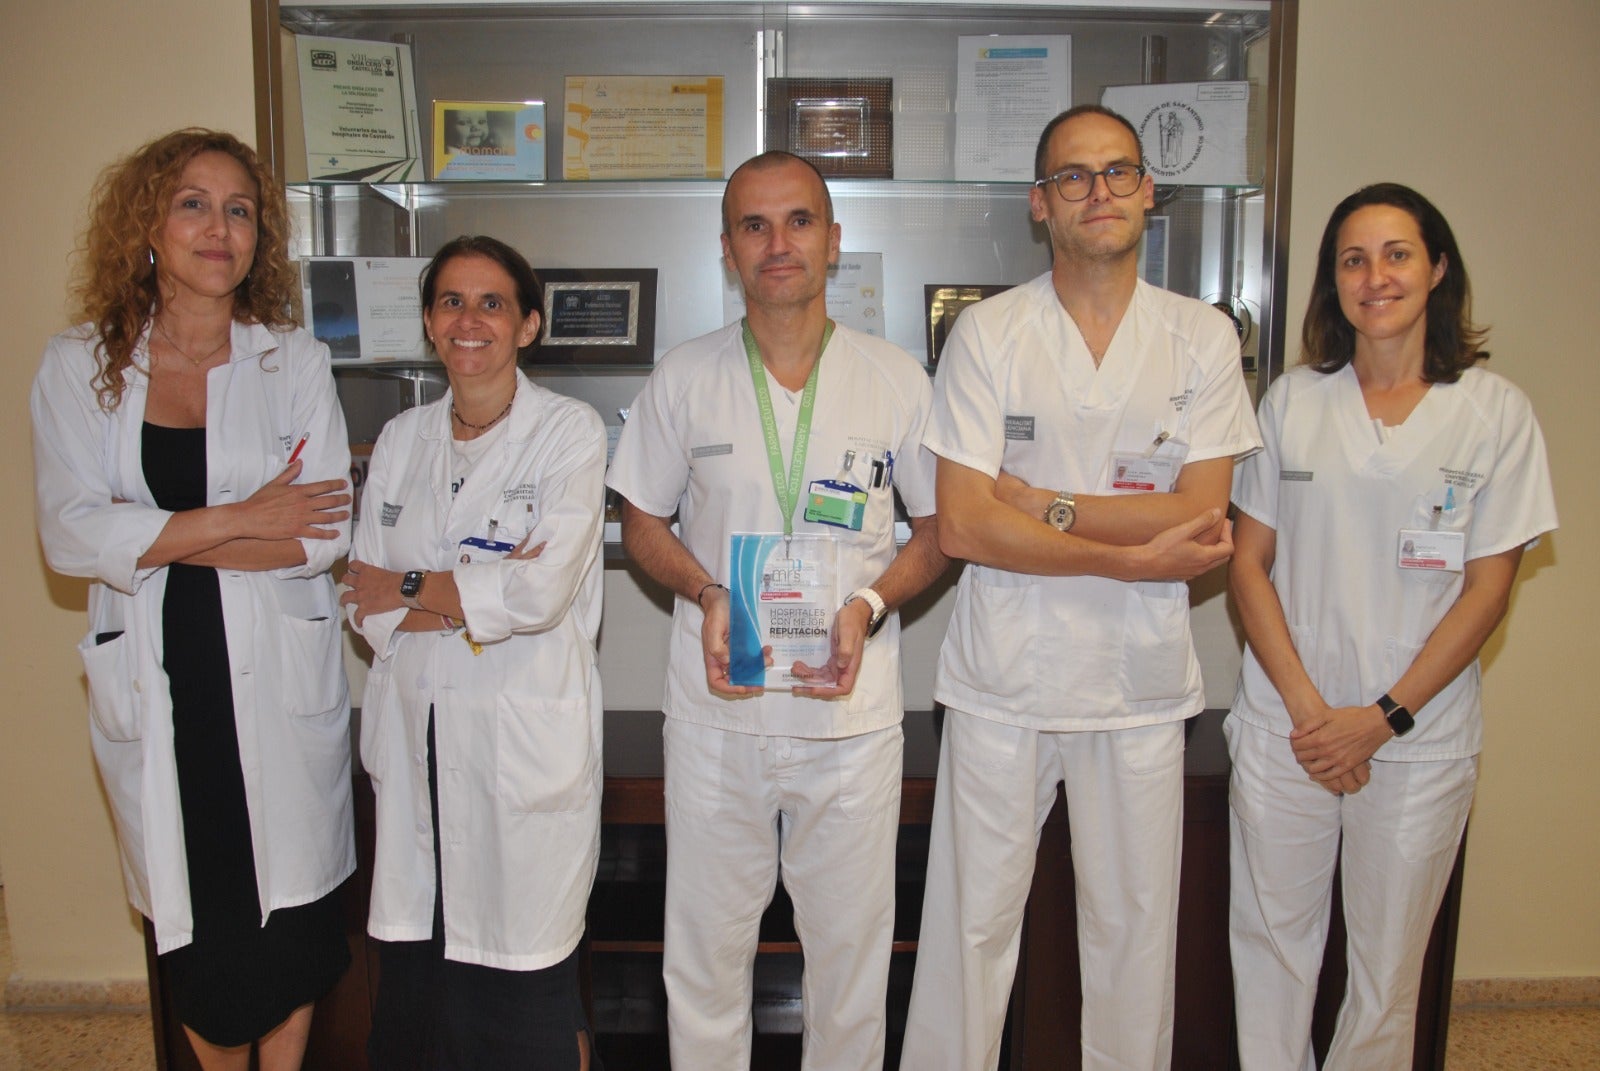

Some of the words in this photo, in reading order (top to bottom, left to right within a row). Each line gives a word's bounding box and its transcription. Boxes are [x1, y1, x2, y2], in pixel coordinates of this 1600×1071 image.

[338, 126, 371, 134] Voluntarios
[331, 131, 361, 139] hospitales
[770, 608, 826, 617] HOSPITALES
[771, 618, 791, 628] CON
[793, 618, 826, 628] MEJOR
[768, 626, 829, 637] REPUTACIÓN
